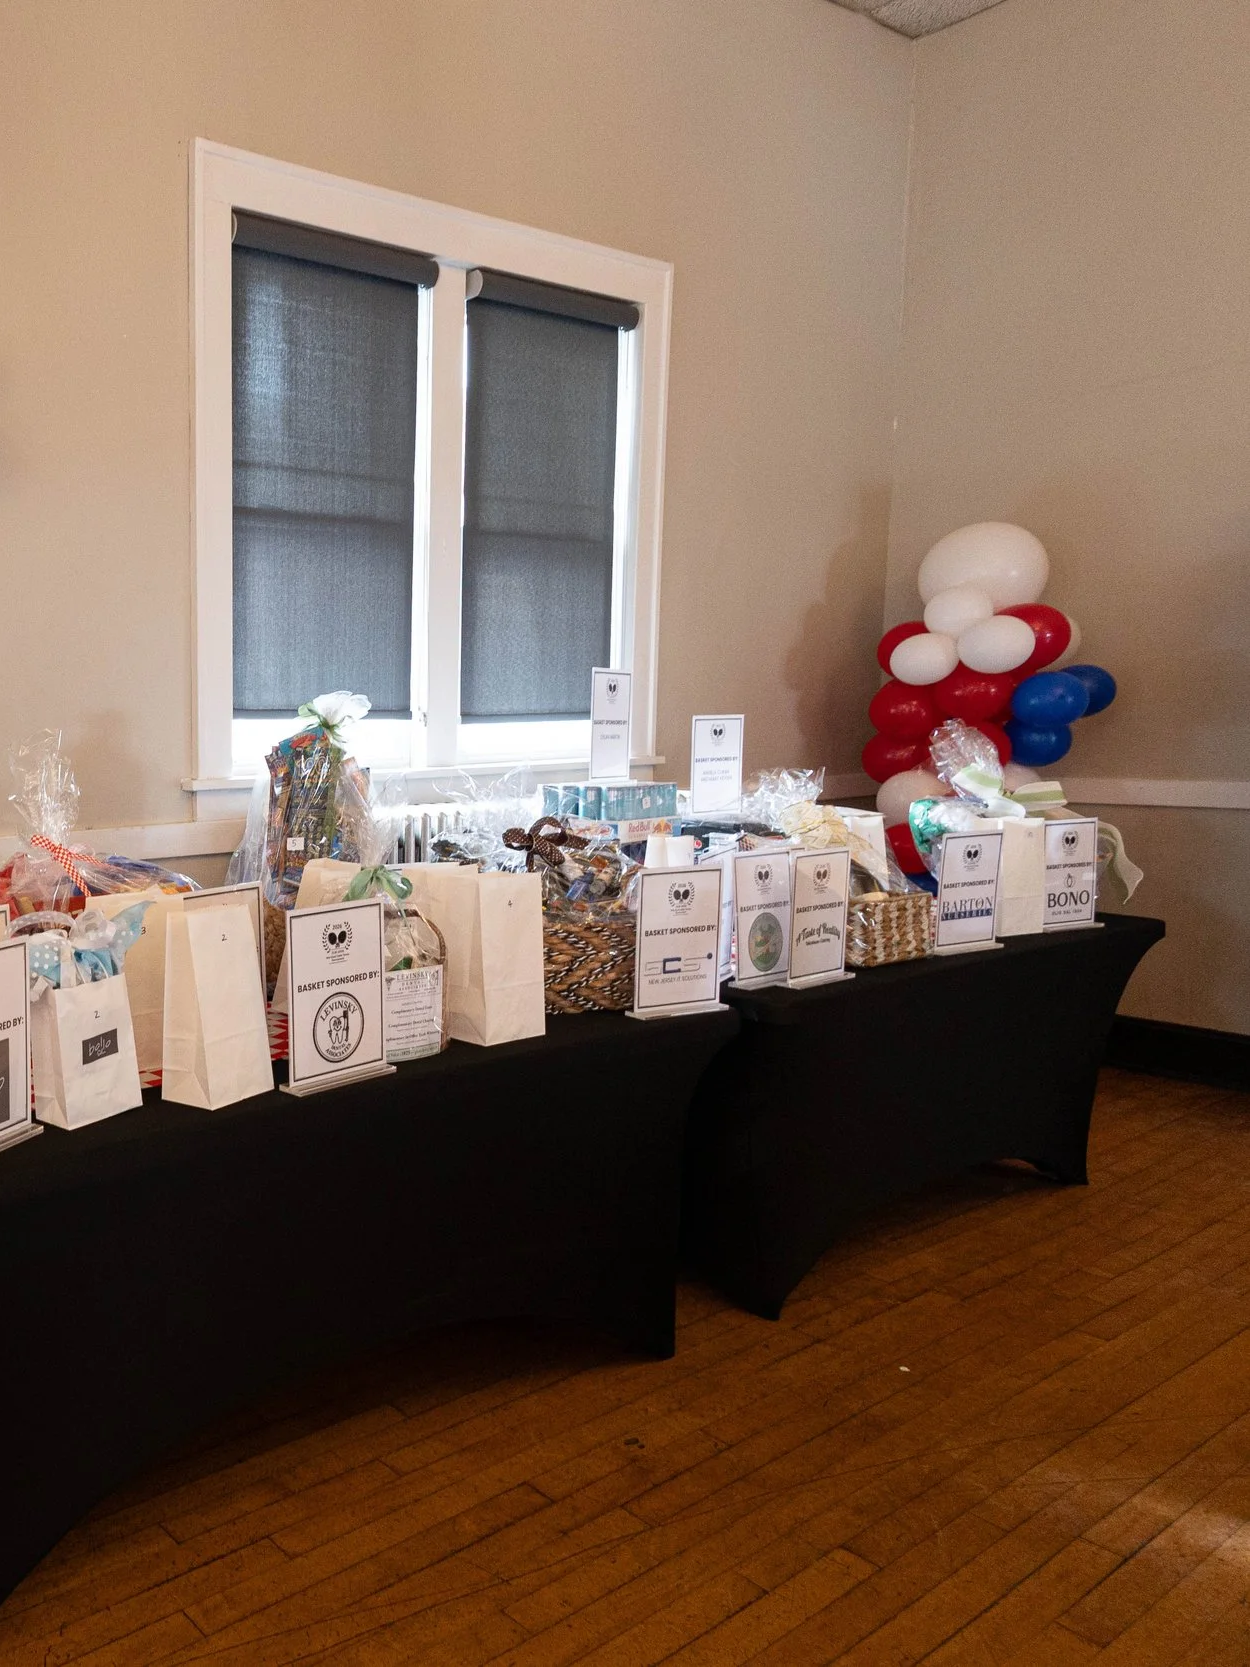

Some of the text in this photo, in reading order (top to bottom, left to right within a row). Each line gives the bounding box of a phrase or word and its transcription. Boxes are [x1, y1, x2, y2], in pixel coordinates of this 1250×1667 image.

[942, 896, 993, 913] BARTON
[1047, 889, 1090, 908] BONO
[740, 904, 757, 913] BASKET
[757, 902, 783, 910] SPONSORED
[796, 905, 812, 914] BASKET
[813, 903, 837, 912] SPONSORED
[645, 924, 716, 937] BASKET SPONSORED BY:
[297, 970, 379, 993] BASKET SPONSORED BY:
[681, 974, 707, 982] SOLUTIONS
[94, 1010, 100, 1019] 2
[320, 1000, 358, 1022] LEVINSKY
[12, 1016, 24, 1030] BY:
[88, 1036, 112, 1057] bollo
[325, 1043, 352, 1058] ASSOCIATES
